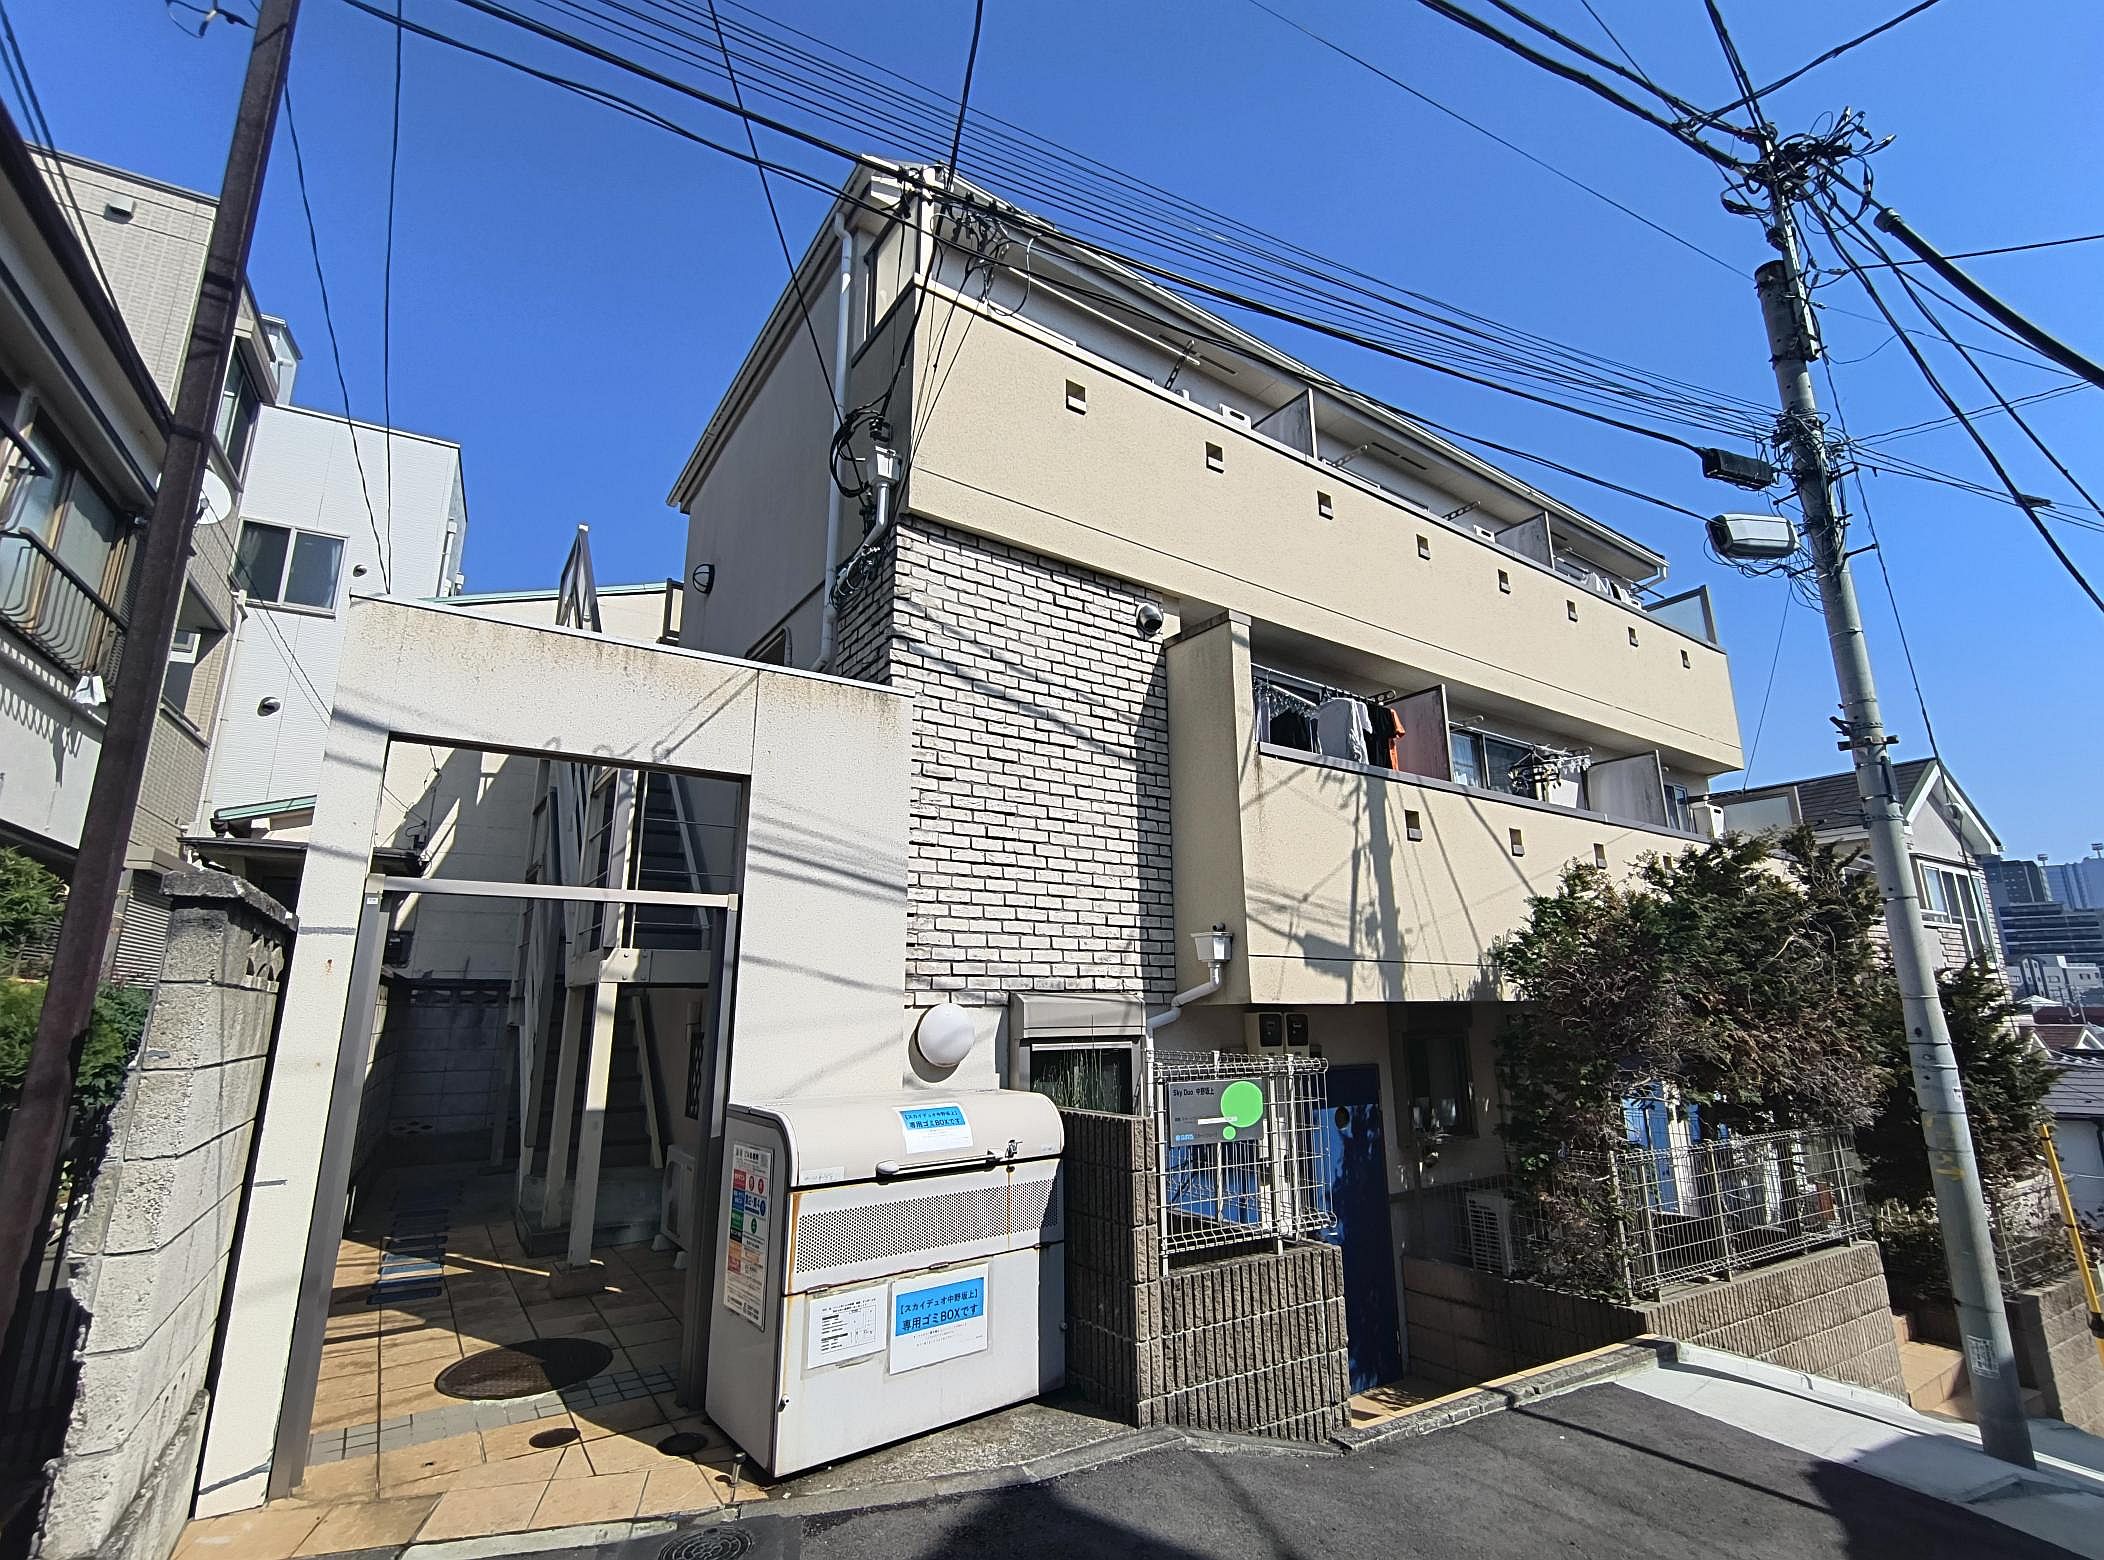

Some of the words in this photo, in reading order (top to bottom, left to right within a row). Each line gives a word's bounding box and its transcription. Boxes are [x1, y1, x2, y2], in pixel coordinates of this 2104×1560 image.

[1173, 1089, 1183, 1098] Sky
[1184, 1088, 1193, 1096] Duo
[900, 1289, 978, 1315] 【スカイデュオ中野坂上】
[903, 1304, 979, 1331] 専用ゴミBOXです
